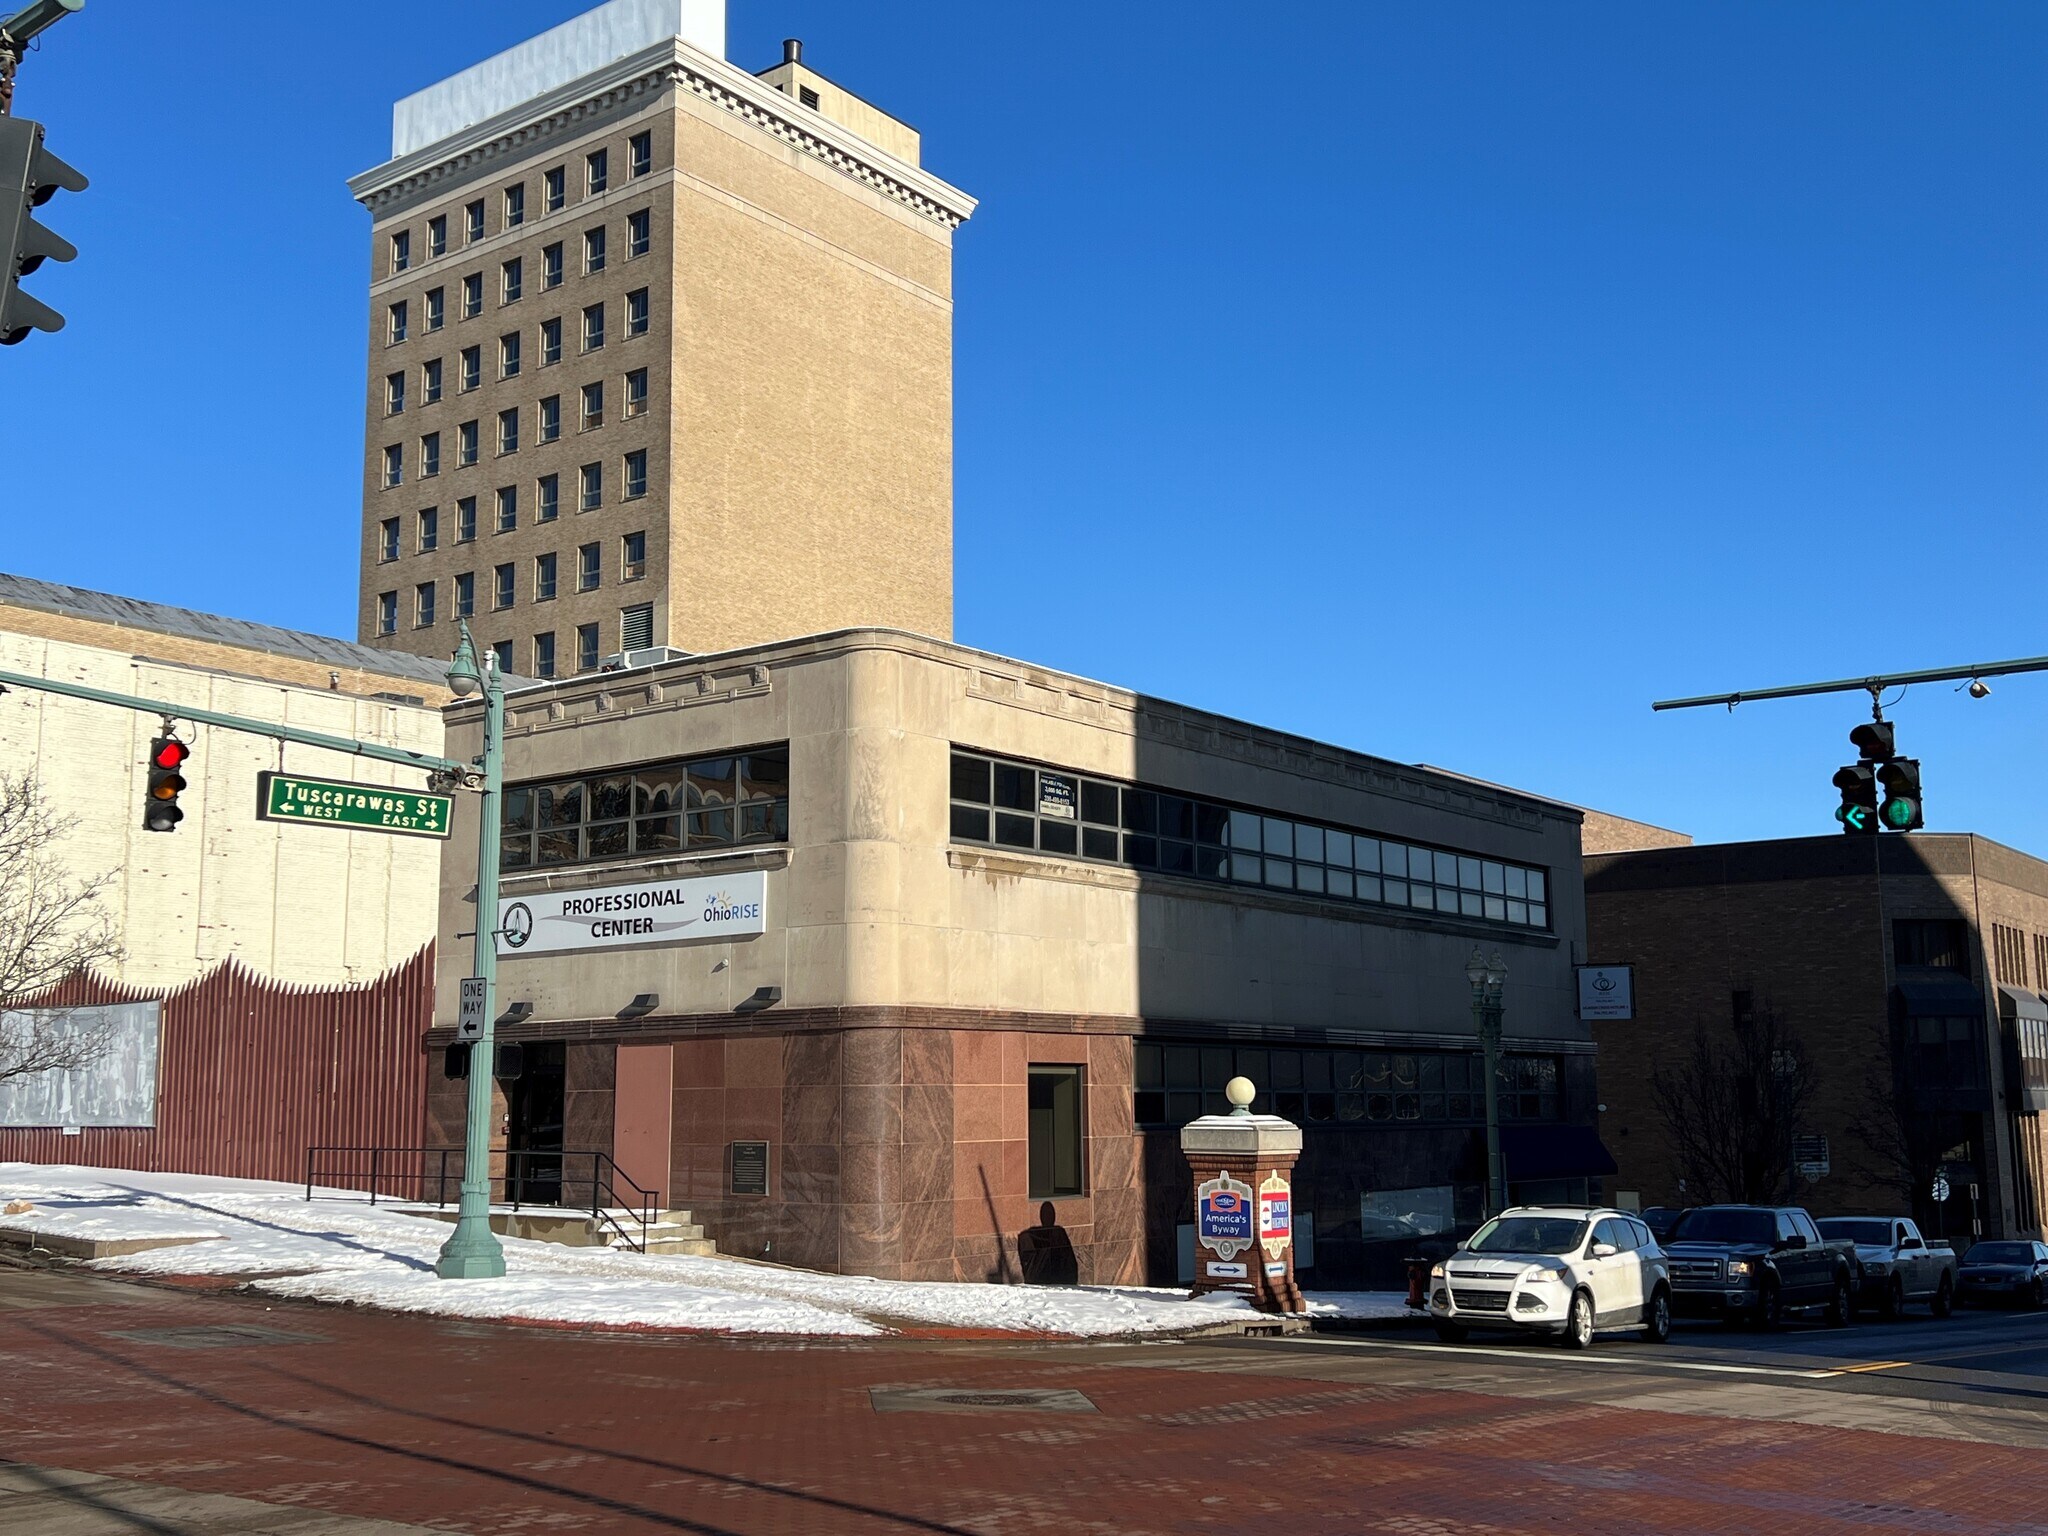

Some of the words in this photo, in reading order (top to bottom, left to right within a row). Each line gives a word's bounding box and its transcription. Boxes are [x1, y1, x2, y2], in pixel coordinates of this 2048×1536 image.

[285, 783, 405, 812] Tuscarawas
[416, 799, 437, 817] St
[303, 804, 342, 818] WEST
[382, 814, 419, 827] EAST
[563, 889, 684, 916] PROFESSIONAL
[703, 904, 759, 922] OhioRISE
[591, 917, 654, 938] CENTER
[464, 984, 482, 996] ONE
[463, 1001, 482, 1014] WAY
[1205, 1214, 1247, 1224] America's
[1212, 1225, 1240, 1236] Byway
